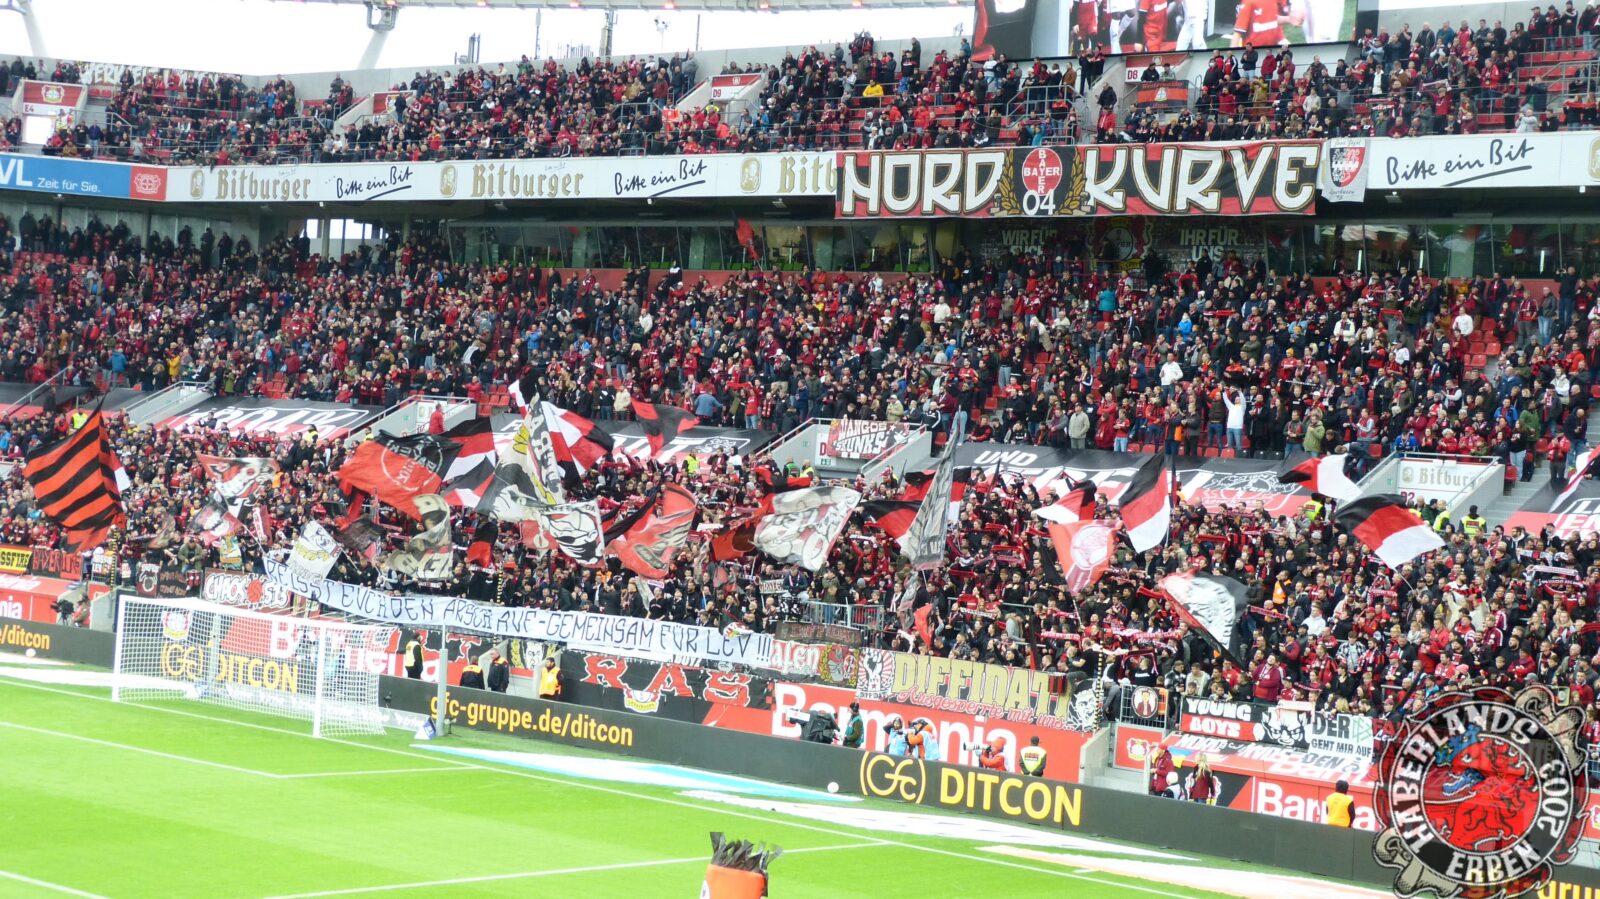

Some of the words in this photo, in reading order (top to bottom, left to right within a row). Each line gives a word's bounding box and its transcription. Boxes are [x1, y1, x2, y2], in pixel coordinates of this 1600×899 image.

[1024, 167, 1062, 177] BAYER
[1386, 156, 1437, 186] Bitte
[1444, 153, 1484, 174] ein
[1489, 138, 1534, 166] Bit
[38, 177, 58, 188] Zeit
[62, 180, 78, 191] für
[81, 181, 101, 193] Sie.
[216, 168, 311, 201] Bitburger
[336, 177, 363, 199] Bitte
[366, 176, 388, 191] ein
[389, 165, 413, 184] Bit
[471, 164, 584, 198] Bitburger
[615, 172, 647, 196] Bitte
[651, 168, 676, 187] ein
[679, 158, 707, 181] Bit
[843, 151, 1006, 214] NORD
[1084, 144, 1321, 213] KURVE
[1022, 190, 1056, 216] 04
[1002, 229, 1031, 246] WIR
[1180, 229, 1208, 246] IHR
[1208, 225, 1239, 246] FÜR
[974, 450, 1039, 467] UND
[390, 597, 434, 622] DEN
[497, 608, 537, 633] AUF
[546, 613, 655, 651] GEMEINSAM
[659, 622, 698, 652] FÜR
[430, 692, 633, 747] gfc-gruppe.de/ditcon
[897, 686, 1004, 718] Ausgesperrte
[1007, 707, 1034, 725] mit
[1186, 698, 1252, 721] YOUNG
[1312, 711, 1351, 739] DER
[1311, 738, 1335, 751] GEHT
[1336, 742, 1354, 754] MIR
[1301, 752, 1346, 769] DEN
[938, 767, 1082, 827] DITCON
